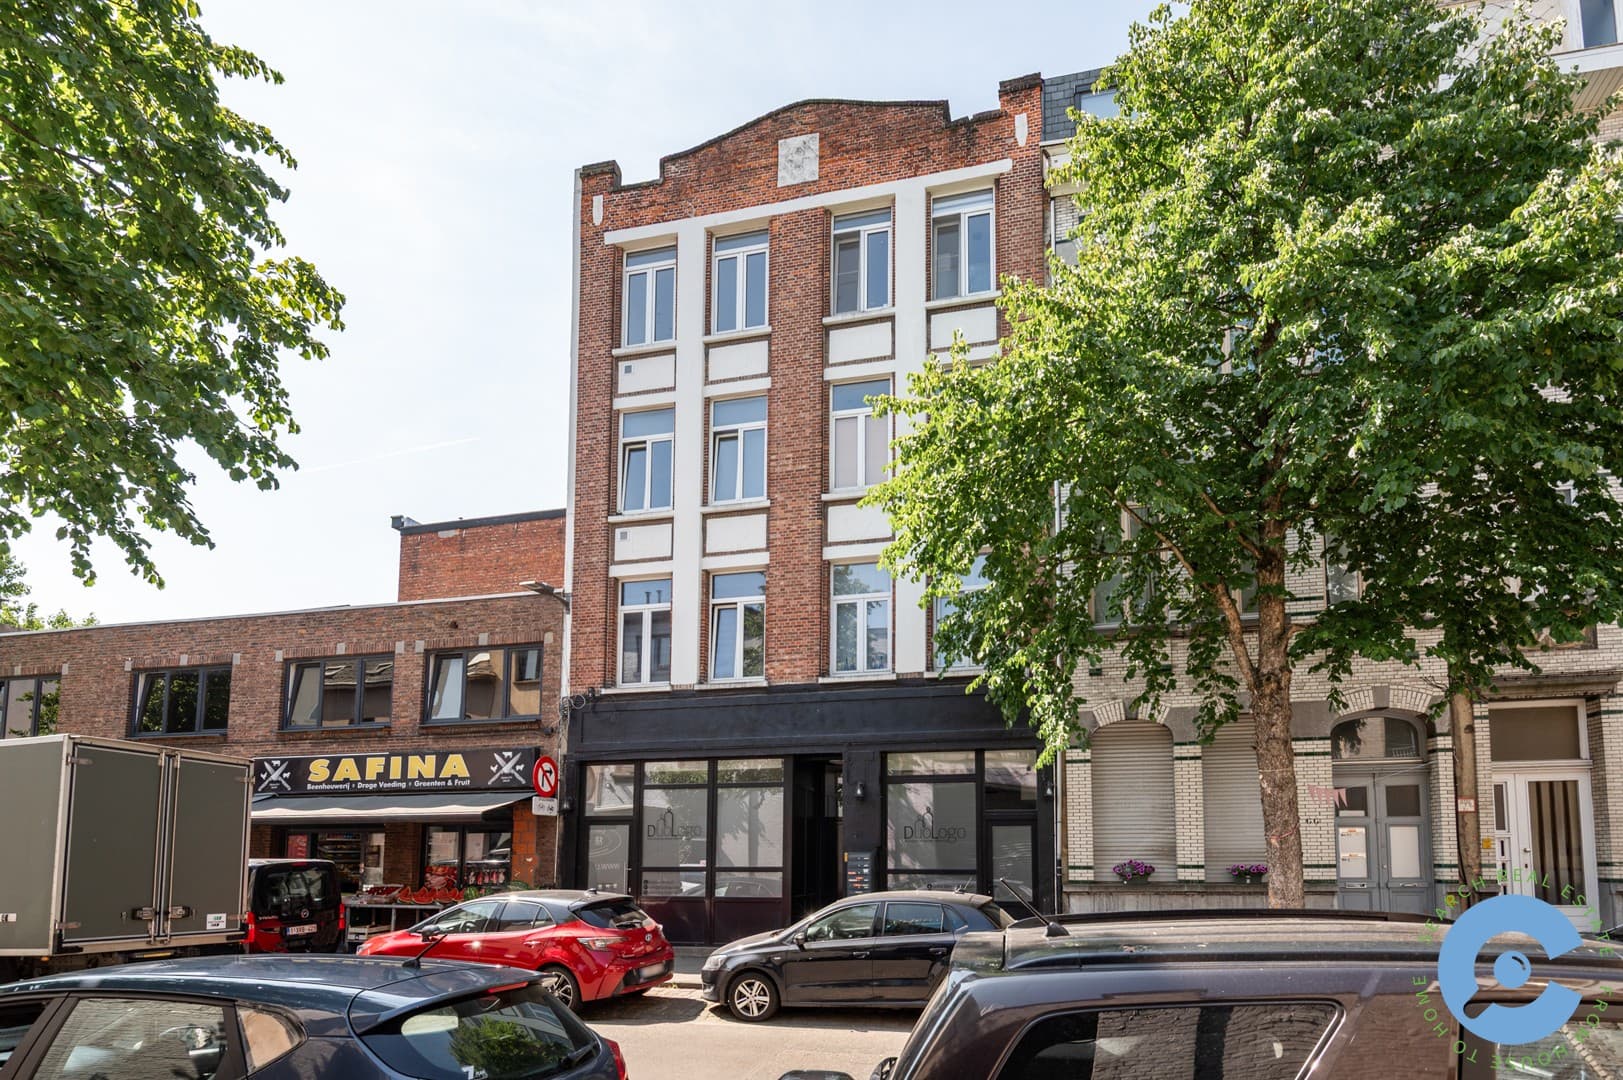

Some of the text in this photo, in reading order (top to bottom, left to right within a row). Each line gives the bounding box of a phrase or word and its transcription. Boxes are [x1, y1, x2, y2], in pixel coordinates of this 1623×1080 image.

[307, 753, 471, 782] SAFINA
[307, 782, 351, 791] Beenhouwerij
[357, 781, 378, 790] Droge
[414, 779, 446, 787] Groenten
[454, 778, 471, 786] Fruit
